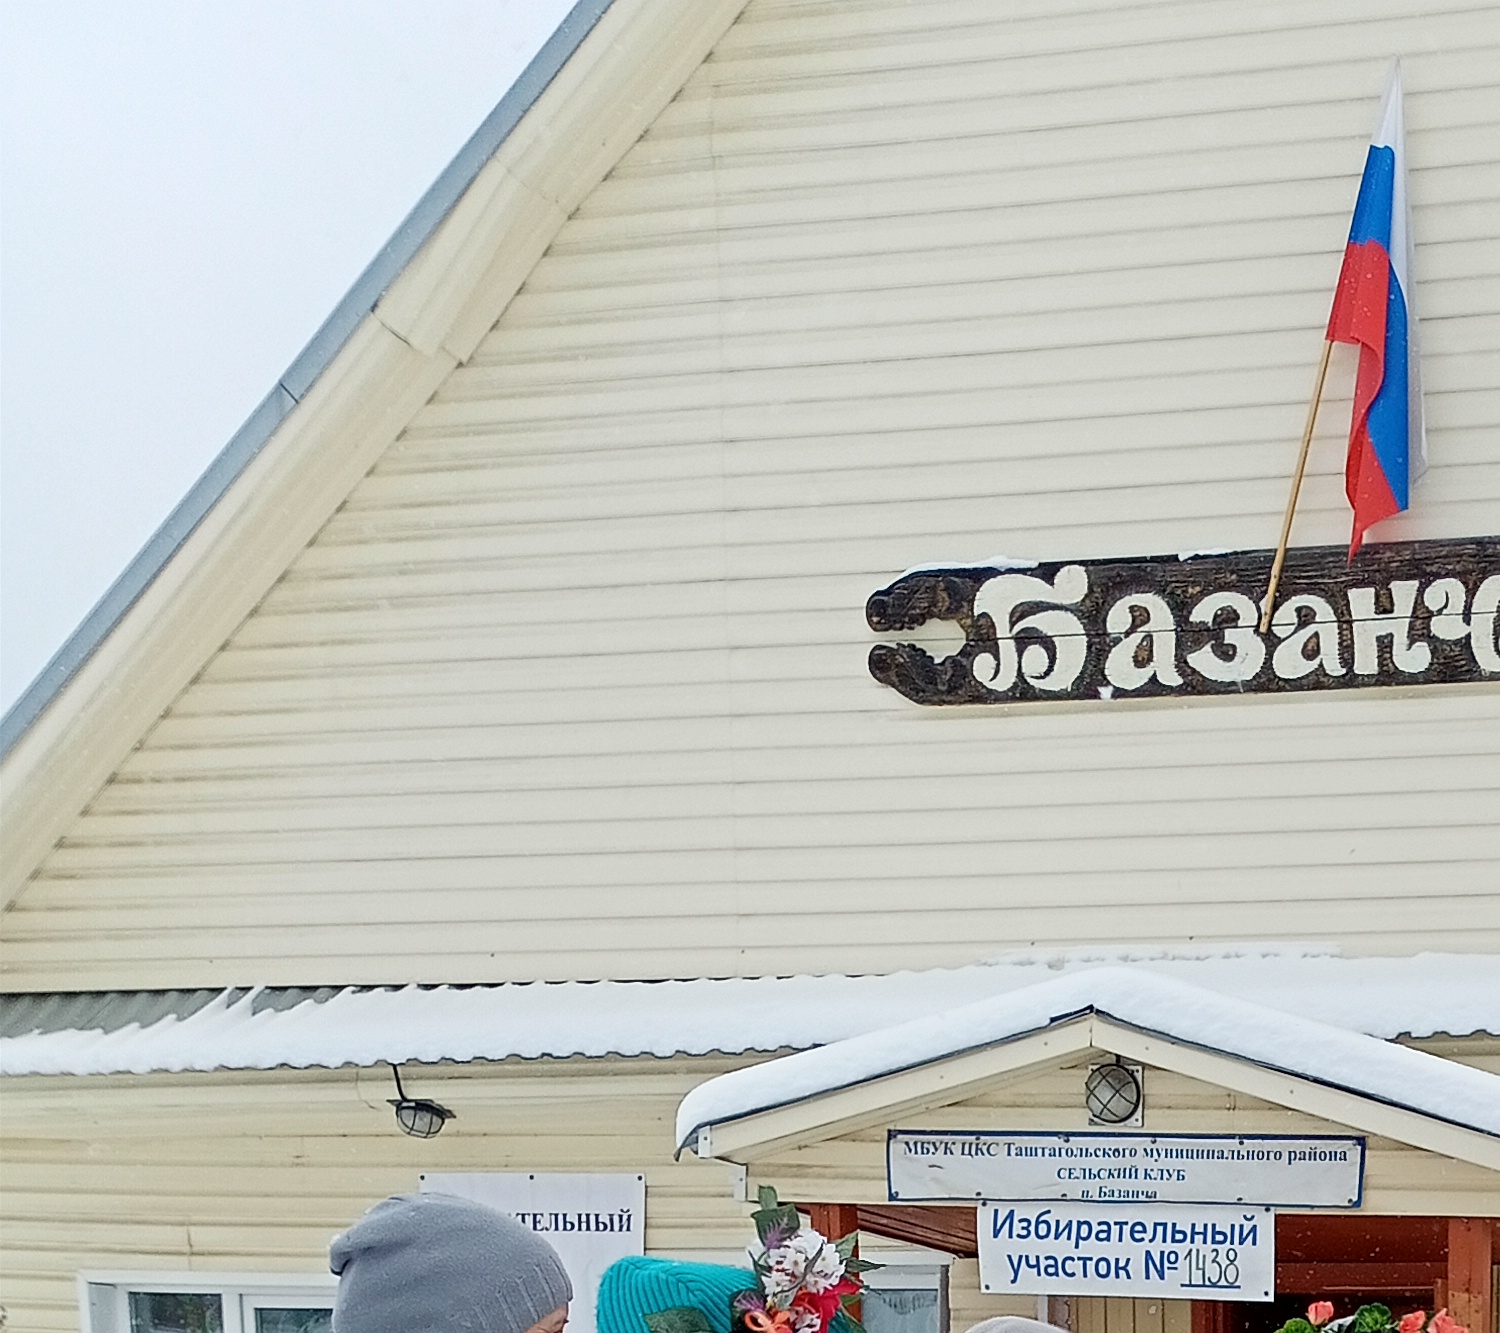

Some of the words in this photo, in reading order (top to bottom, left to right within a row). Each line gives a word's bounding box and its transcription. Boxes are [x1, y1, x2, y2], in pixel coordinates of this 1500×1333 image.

[904, 1141, 956, 1157] МБУК
[960, 1141, 999, 1159] ЦКС
[1004, 1142, 1138, 1160] Таштагольского
[1142, 1147, 1283, 1163] муниципального
[1287, 1147, 1349, 1166] района
[1056, 1165, 1140, 1181] СЕЛЬСКИЙ
[1143, 1168, 1187, 1182] КЛУБ
[1098, 1185, 1158, 1200] Базанча
[508, 1208, 633, 1232] ТЕЛЬНЫЙ
[991, 1208, 1259, 1250] Избирательный
[1006, 1252, 1132, 1285] участок
